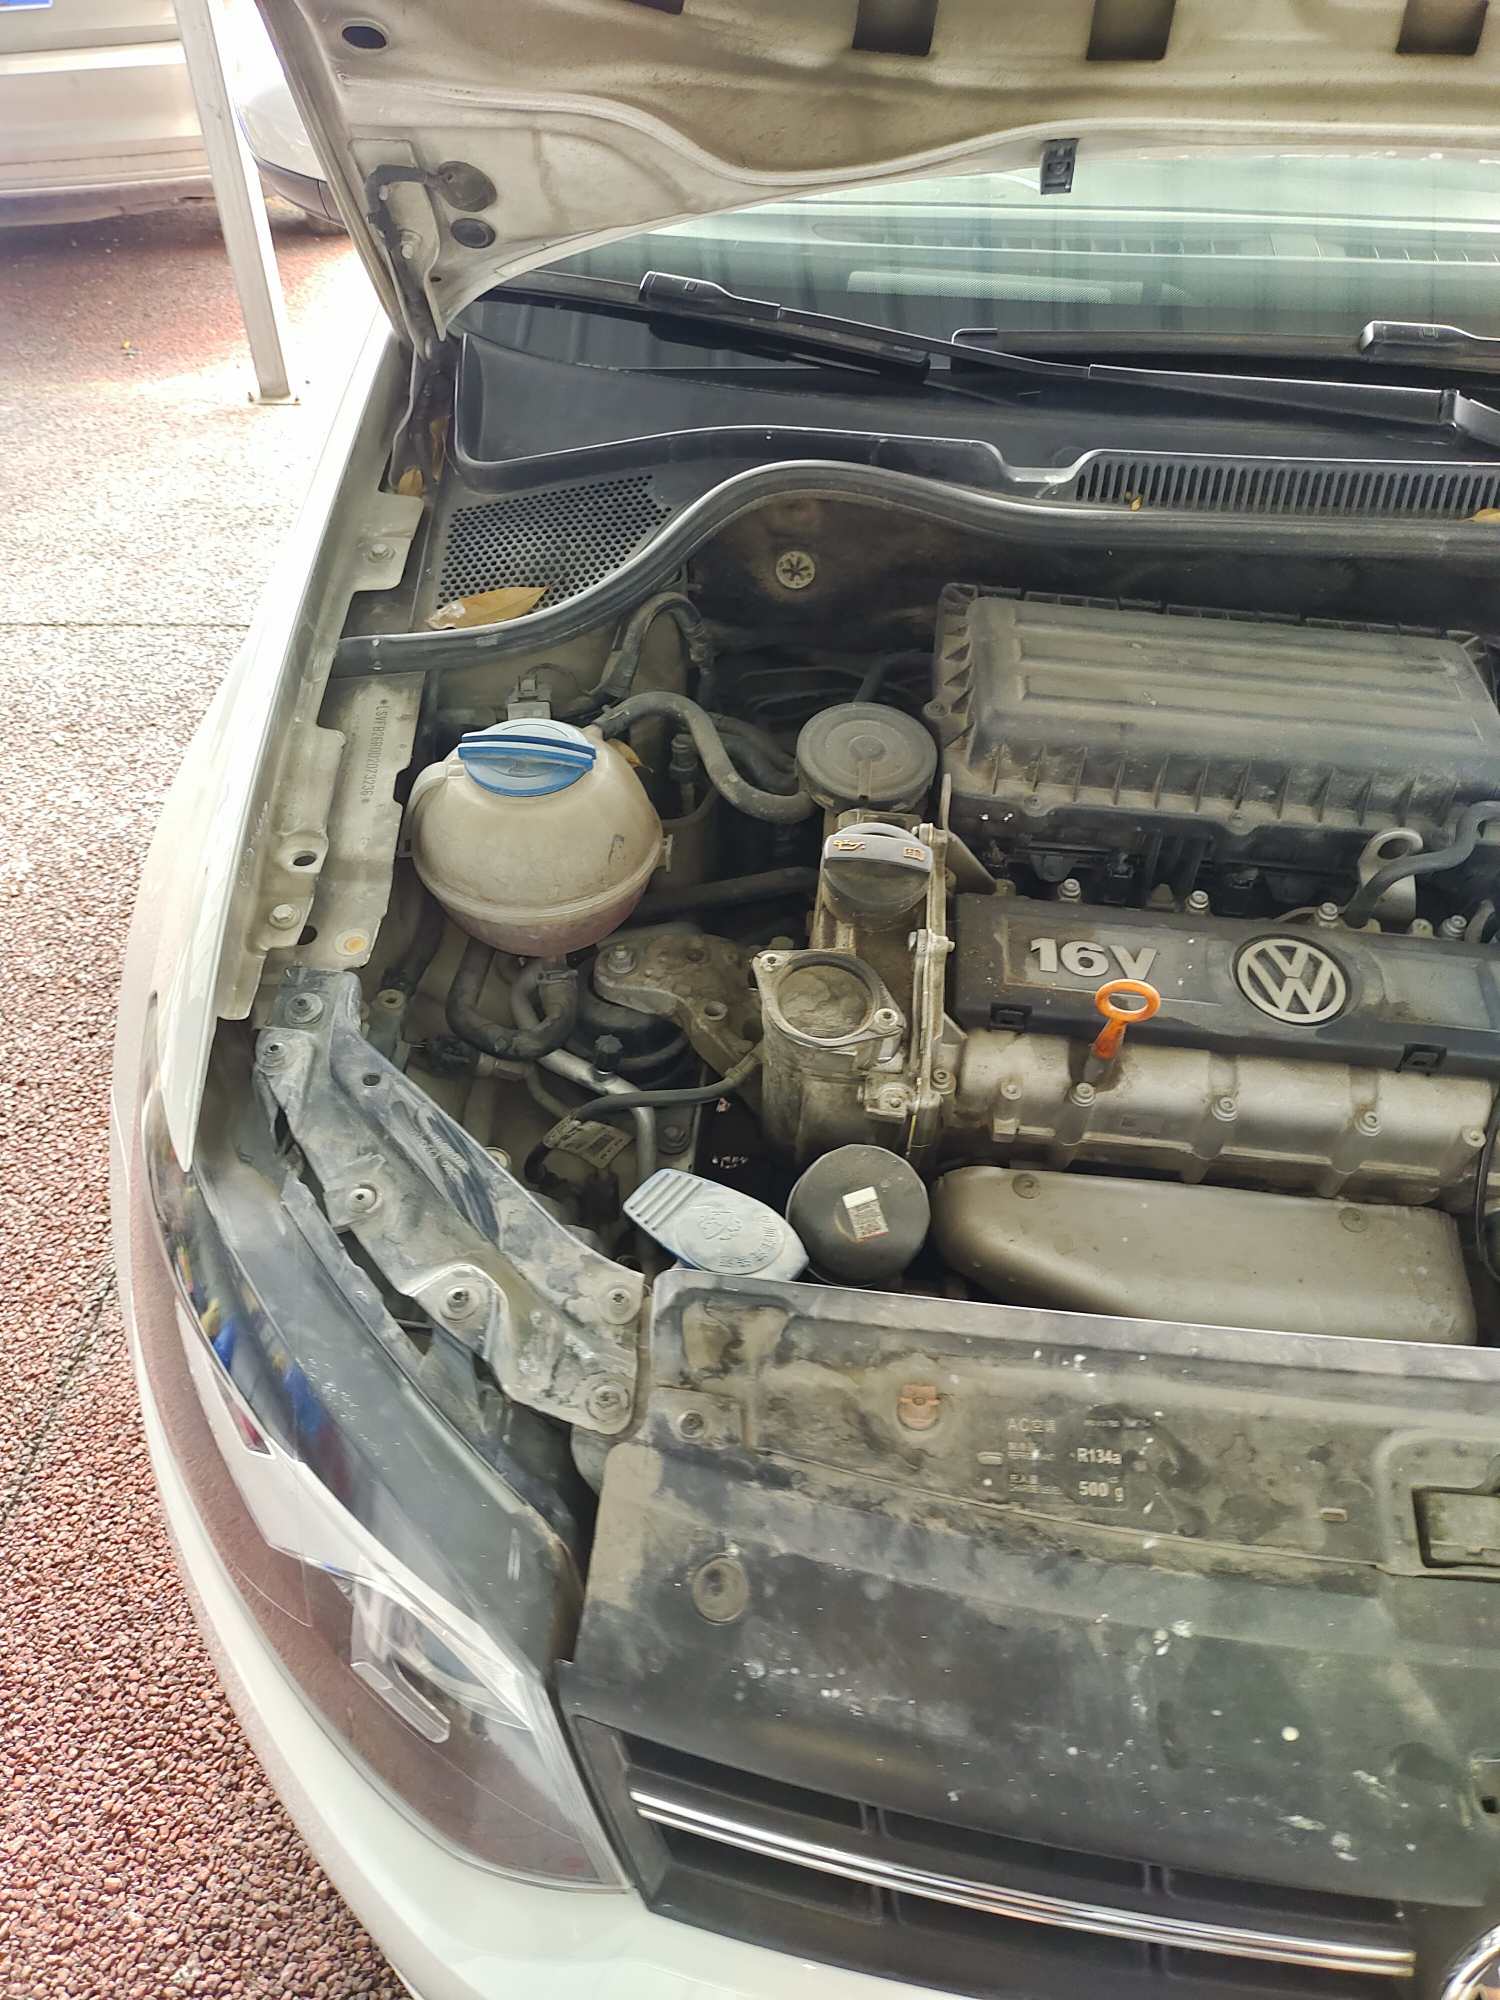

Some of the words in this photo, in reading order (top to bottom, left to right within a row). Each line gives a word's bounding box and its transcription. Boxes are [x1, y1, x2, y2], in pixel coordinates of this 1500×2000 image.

[1030, 937, 1158, 980] 16V
[1238, 938, 1347, 1024] VW
[1077, 1447, 1122, 1465] R134a
[1078, 1480, 1109, 1497] 500
